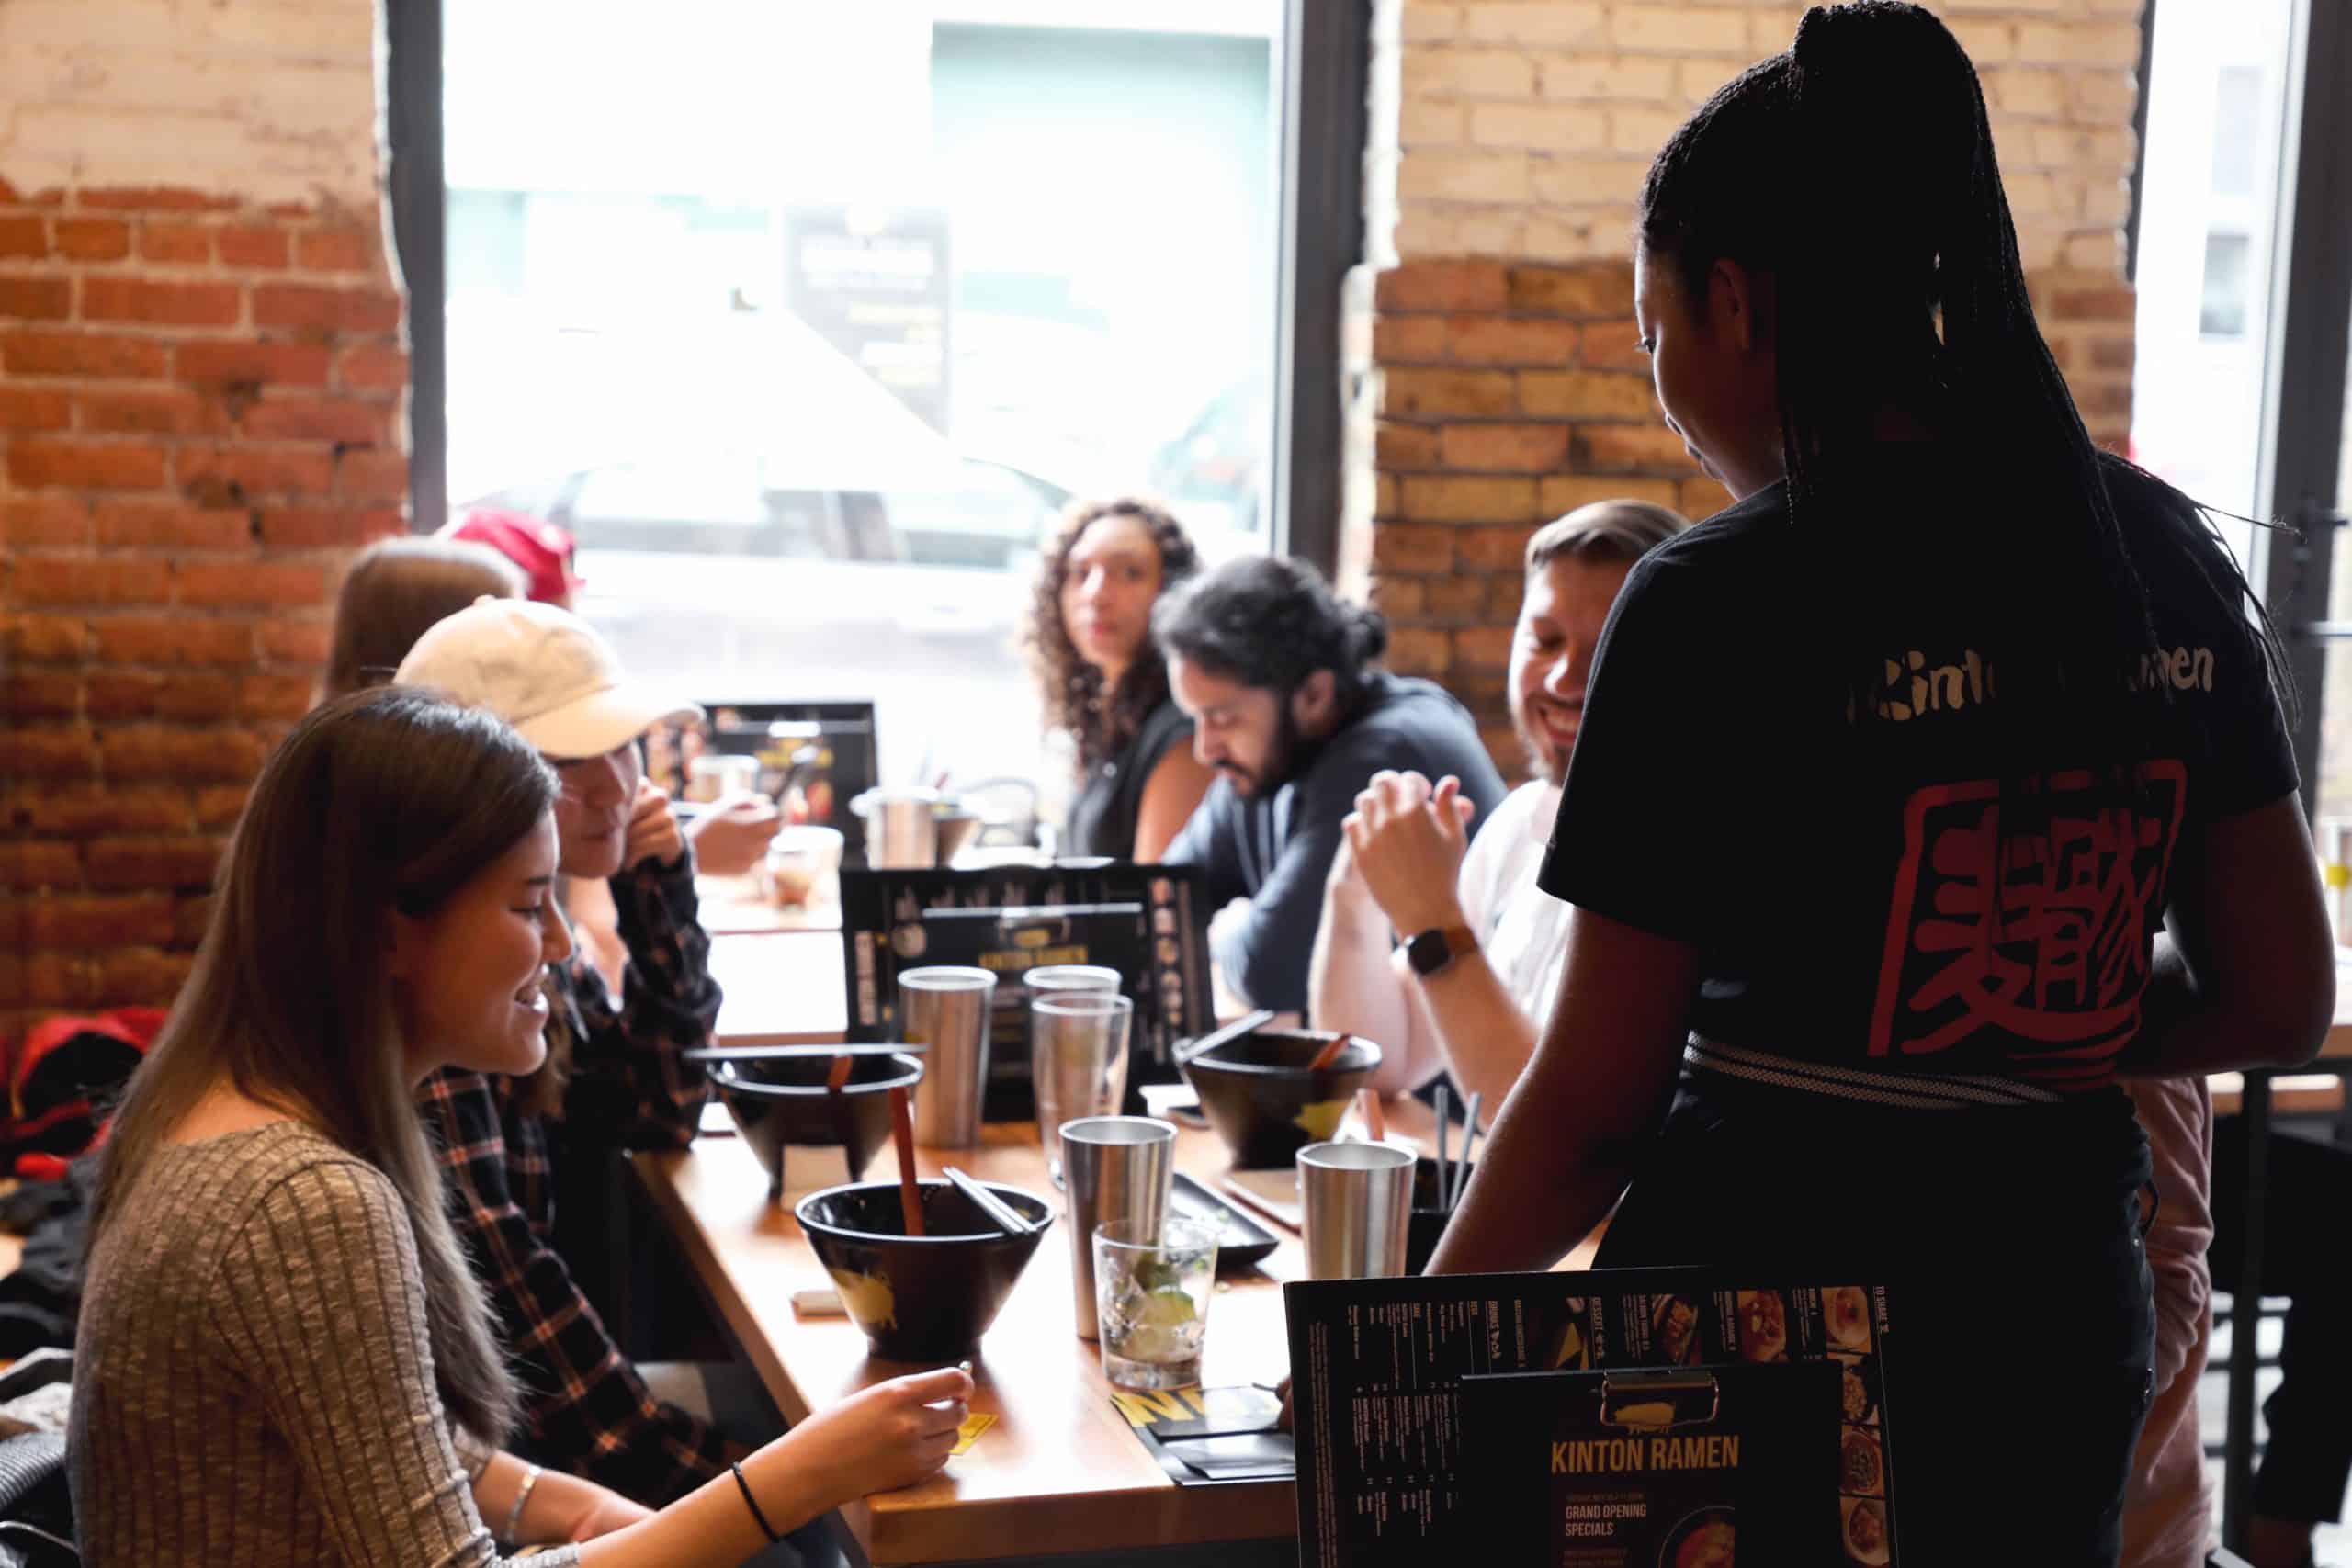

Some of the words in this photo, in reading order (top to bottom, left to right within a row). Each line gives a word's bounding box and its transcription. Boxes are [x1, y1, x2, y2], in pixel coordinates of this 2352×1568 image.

[1551, 1439, 1644, 1474] KINTON
[1651, 1435, 1739, 1471] RAMEN
[1566, 1505, 1600, 1519] GRAND
[1602, 1503, 1646, 1519] OPENING
[1565, 1522, 1614, 1537] SPECIALS
